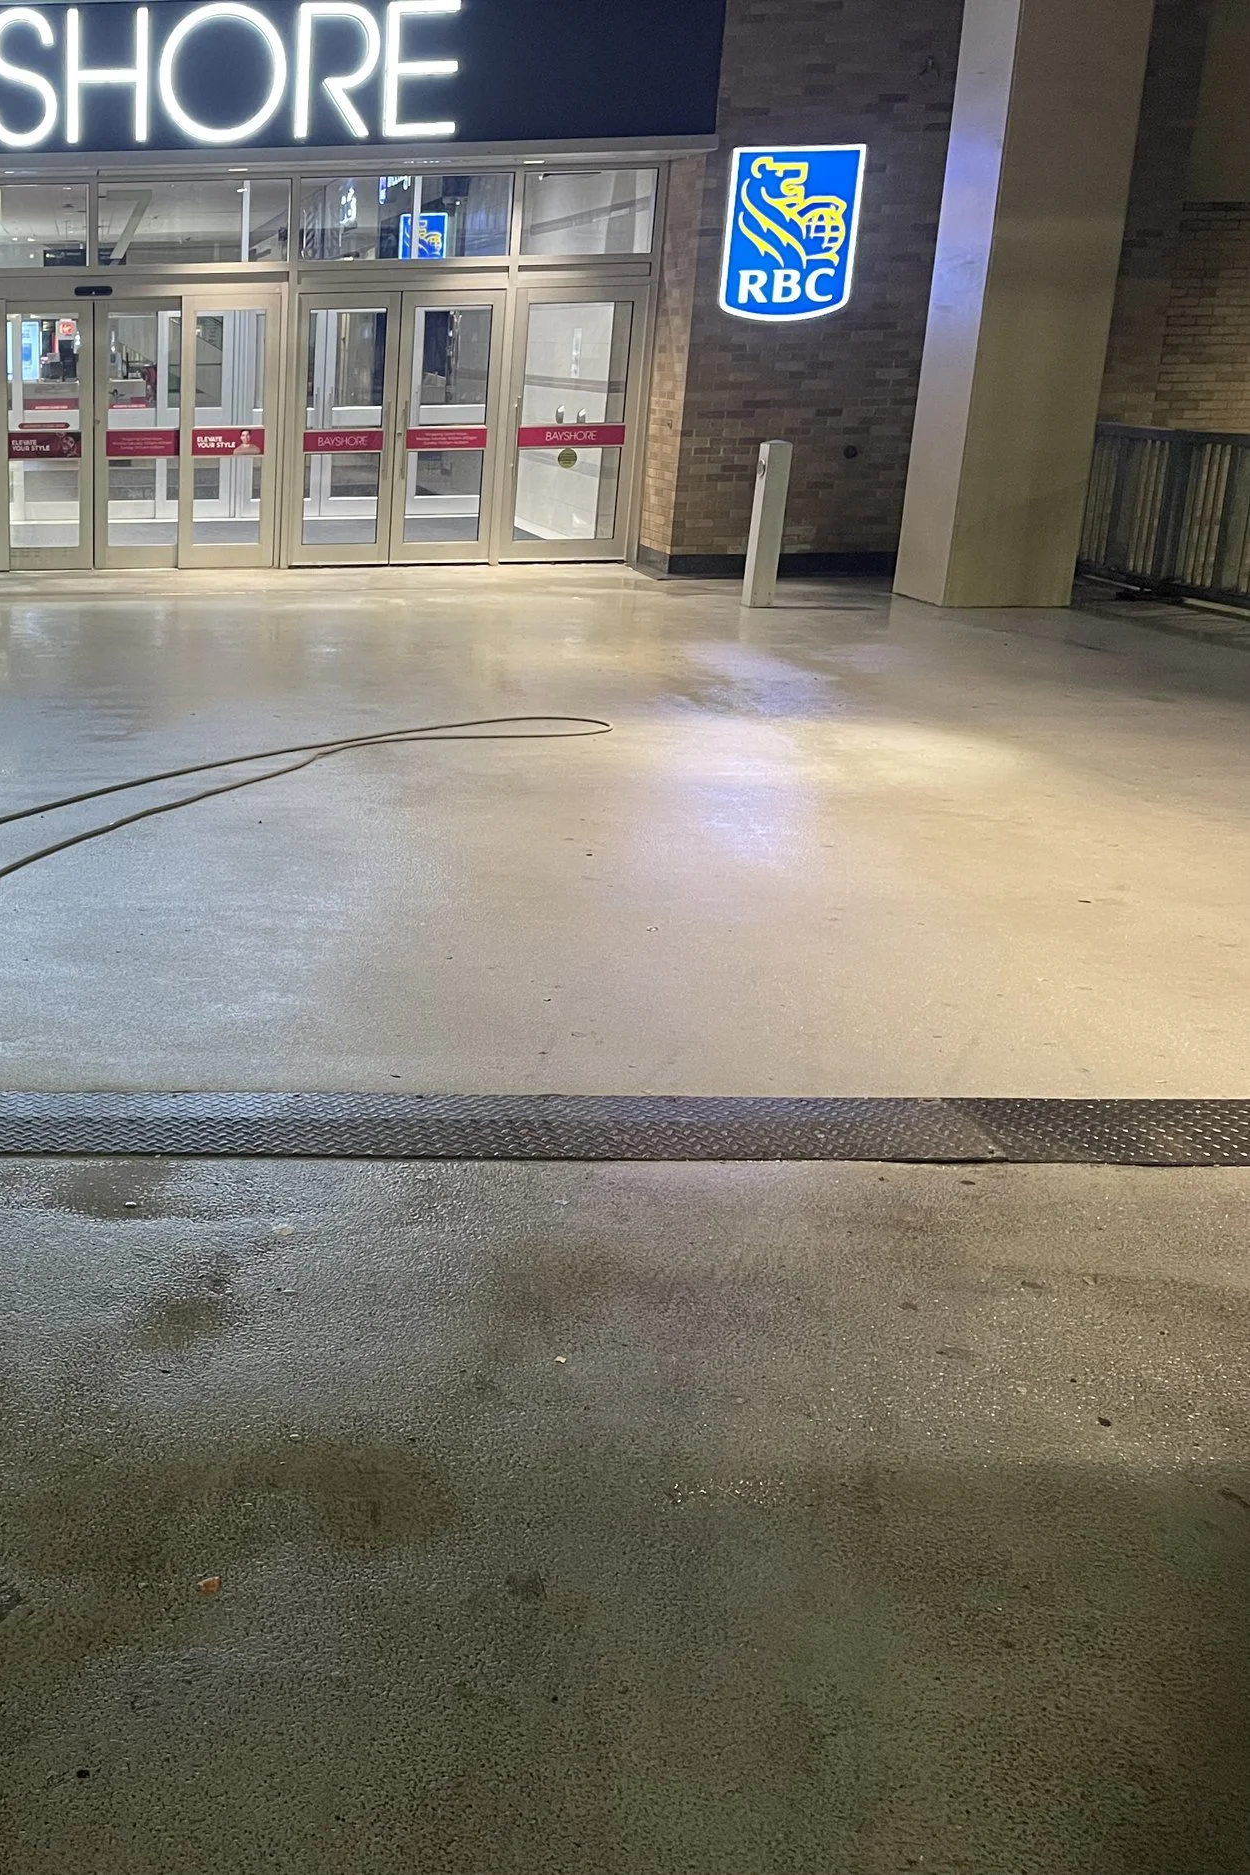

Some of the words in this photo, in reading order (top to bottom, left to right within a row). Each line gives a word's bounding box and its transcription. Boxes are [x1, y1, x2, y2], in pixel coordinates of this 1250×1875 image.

[738, 267, 836, 304] RBC
[317, 435, 369, 447] BAYSHORE
[544, 430, 598, 441] BAYSHORE
[31, 444, 51, 452] STYLE
[216, 441, 236, 449] STYLE
